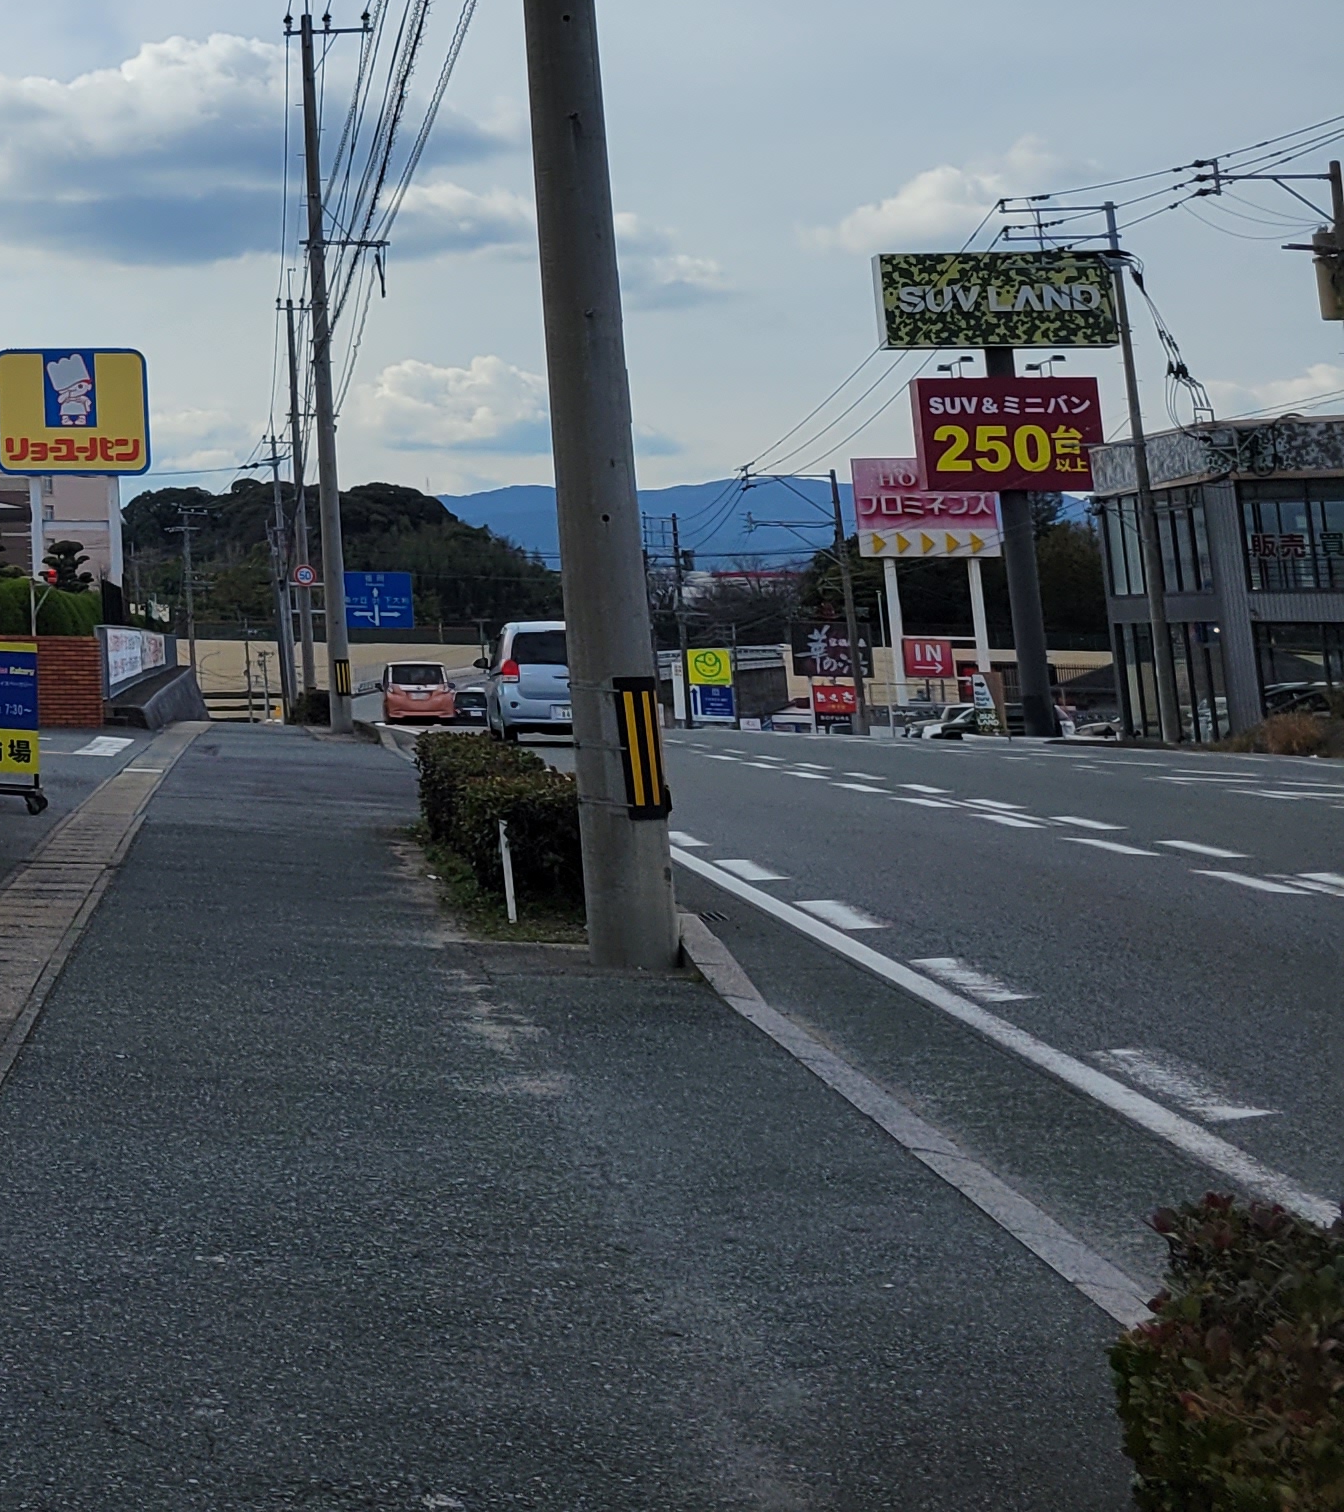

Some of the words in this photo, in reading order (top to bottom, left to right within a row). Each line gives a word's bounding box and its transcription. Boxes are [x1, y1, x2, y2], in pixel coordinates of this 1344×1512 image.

[898, 285, 979, 313] SUV
[988, 285, 1101, 313] LAND
[5, 437, 141, 462] リョーユーパン
[299, 570, 311, 581] 50
[913, 642, 942, 661] IN
